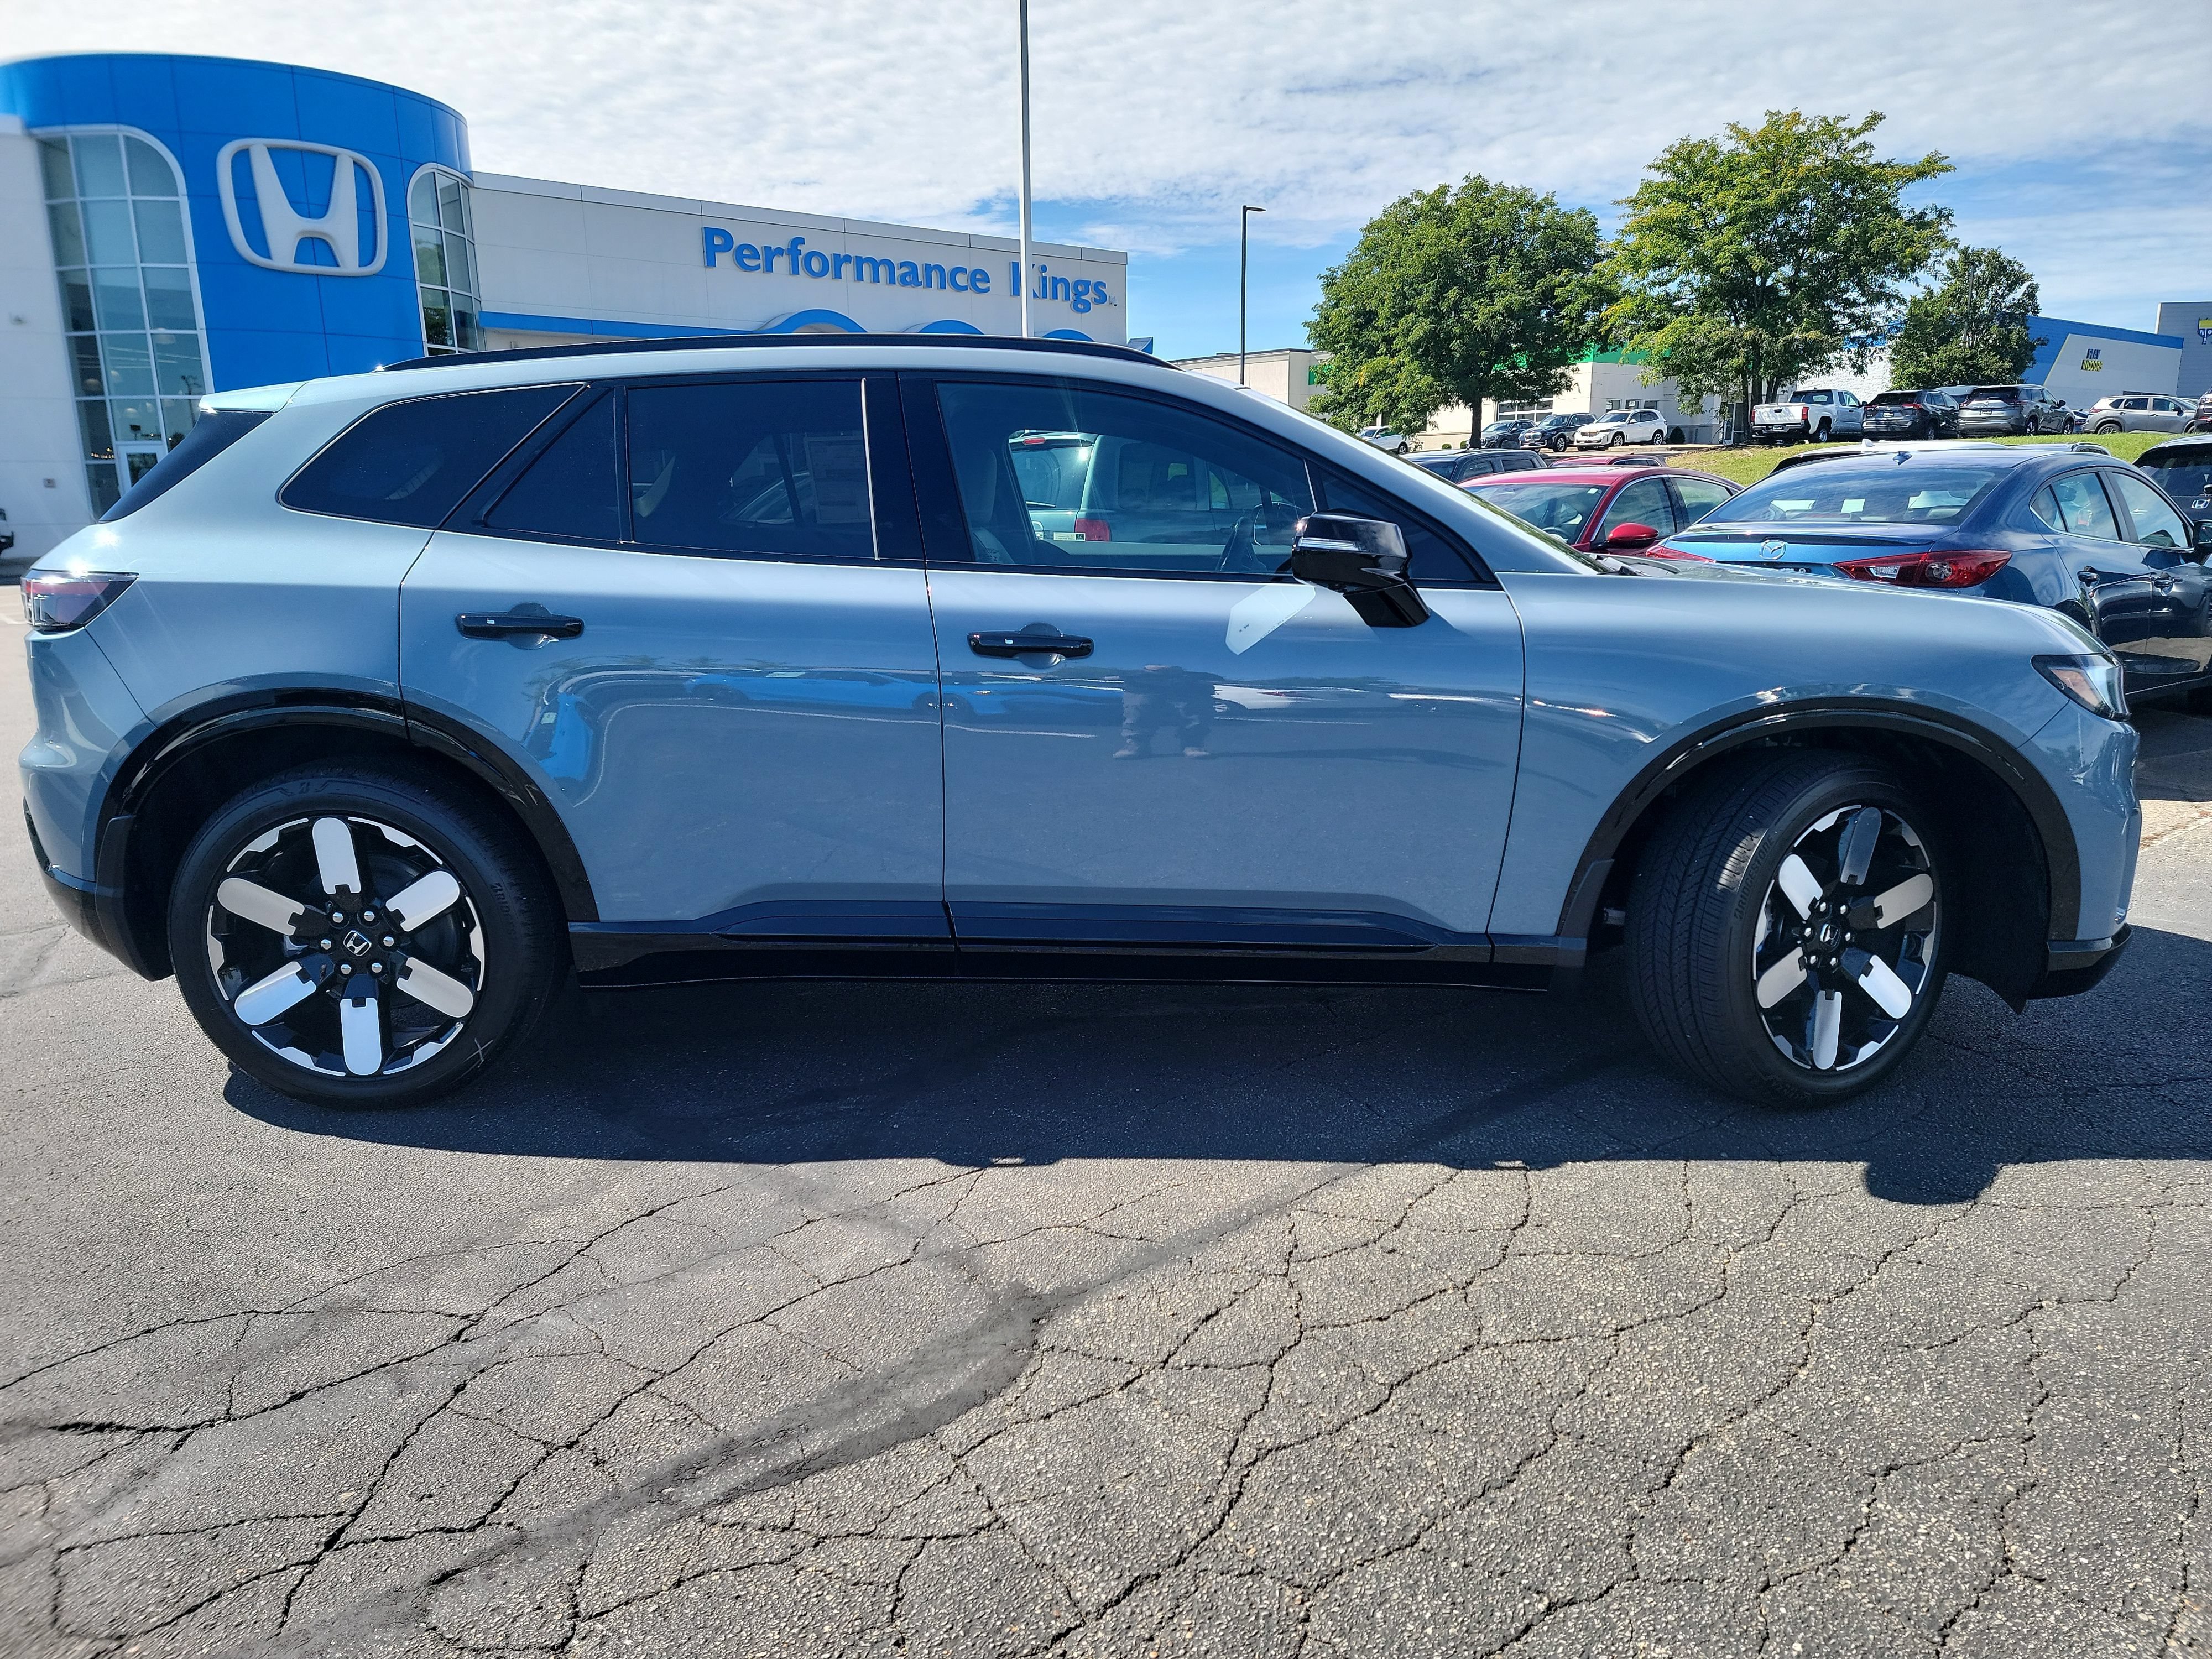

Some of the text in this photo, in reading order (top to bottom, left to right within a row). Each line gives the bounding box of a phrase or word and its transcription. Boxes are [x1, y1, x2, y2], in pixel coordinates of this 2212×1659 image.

[703, 227, 990, 293] Performance
[2086, 348, 2101, 359] PLAY
[2081, 359, 2103, 372] INDOORS
